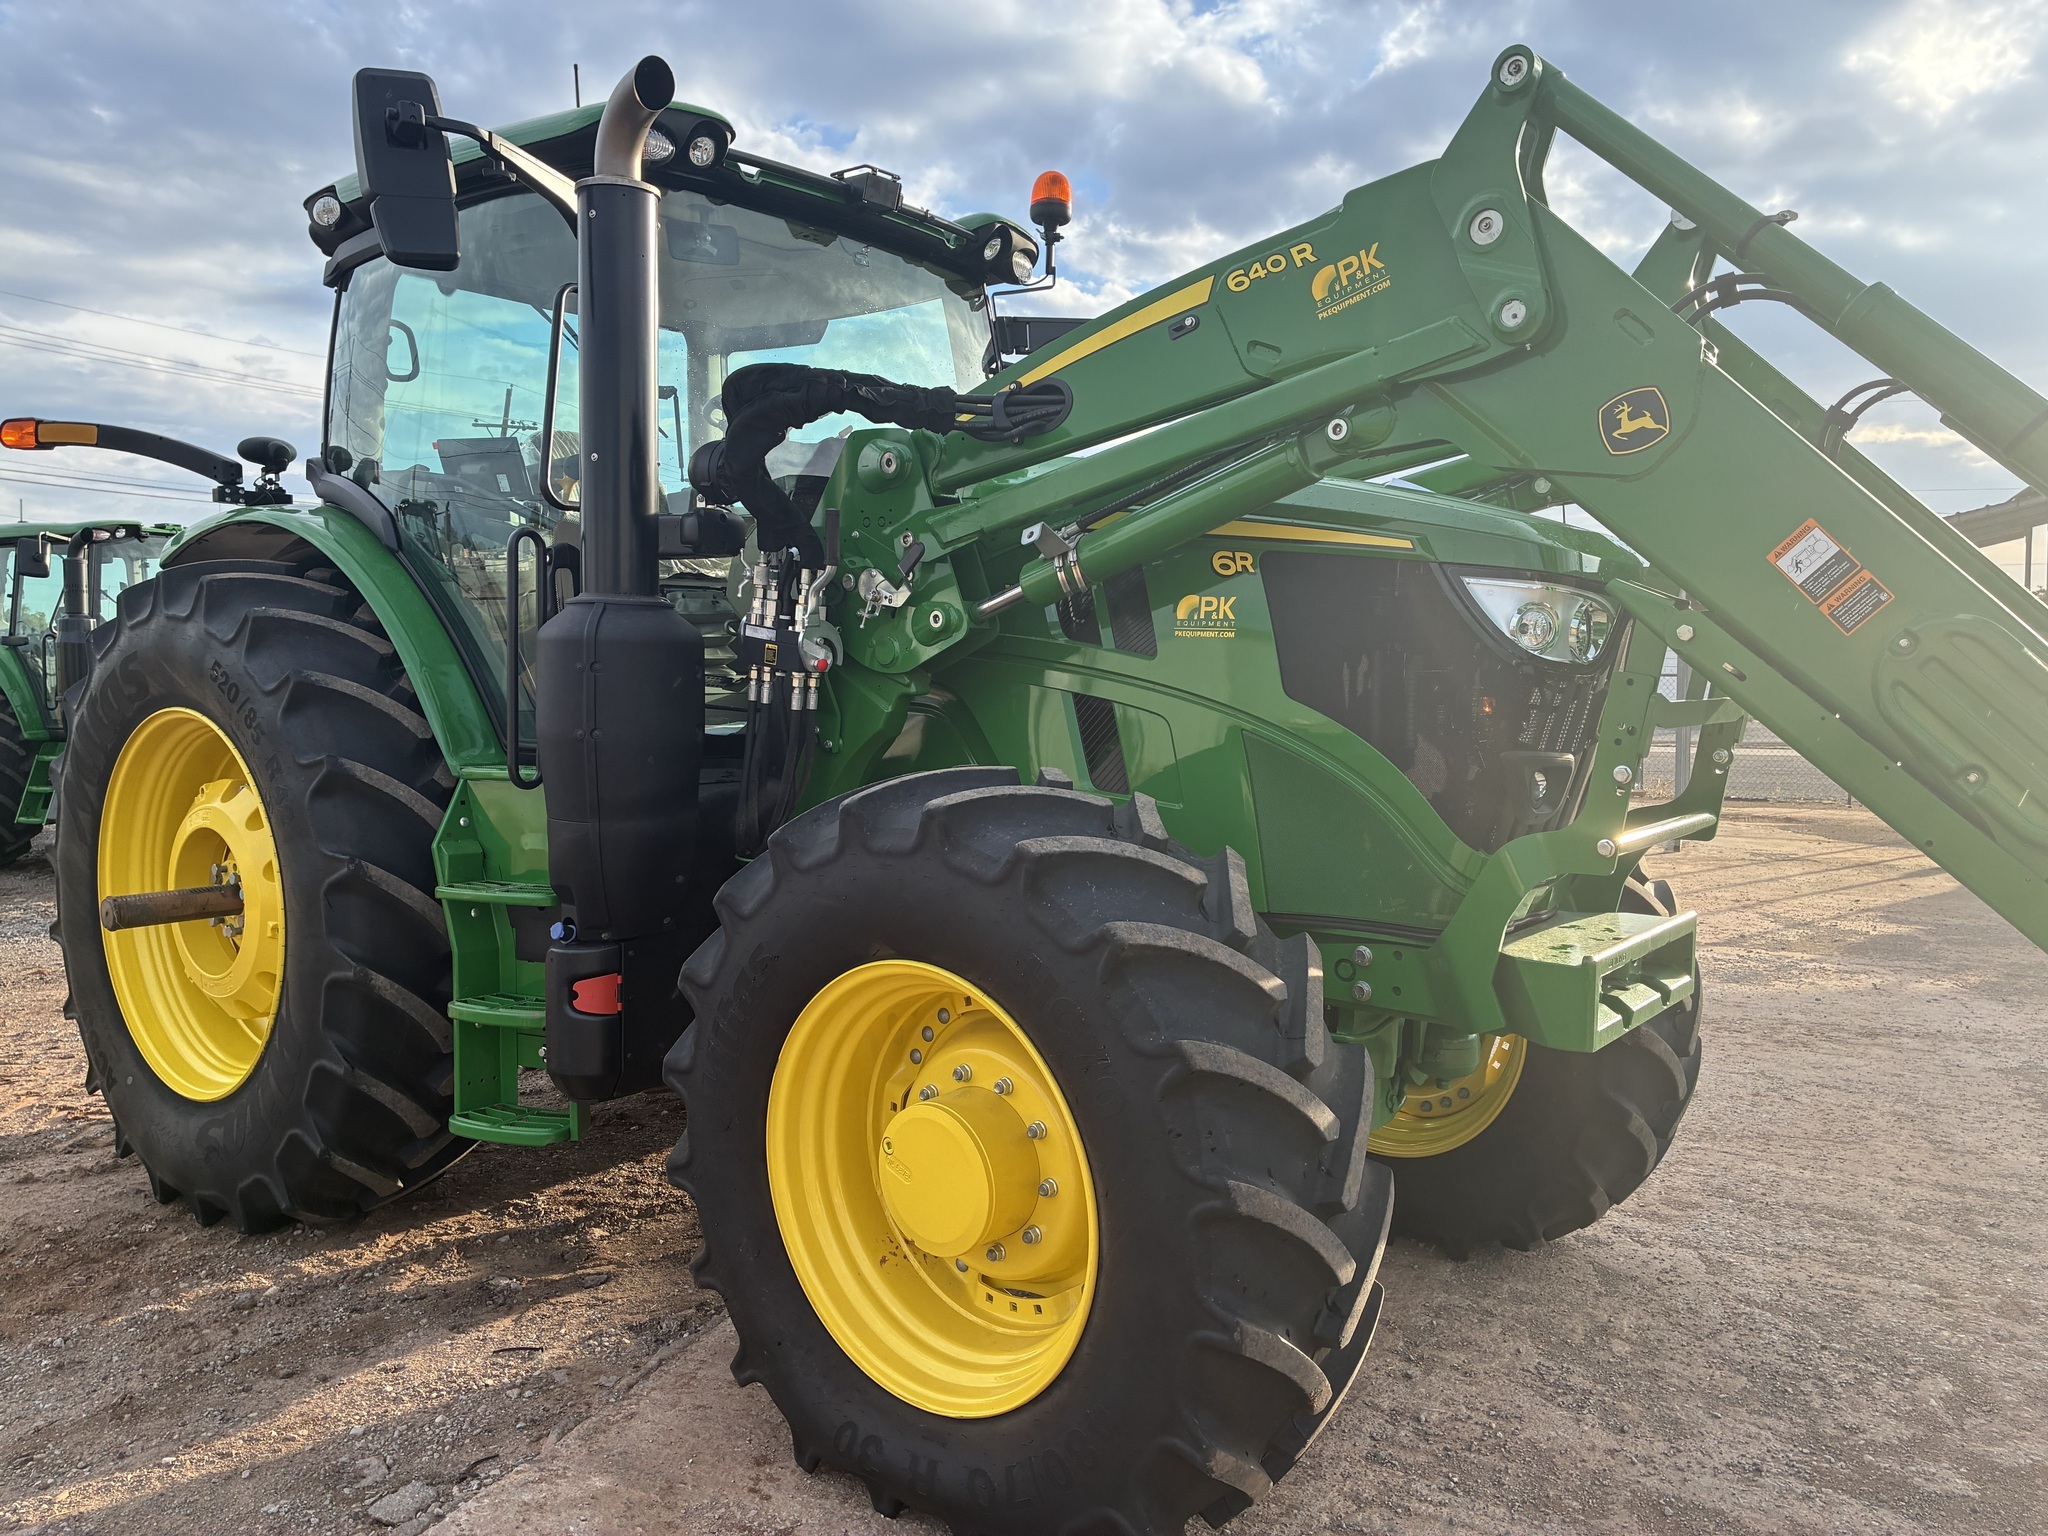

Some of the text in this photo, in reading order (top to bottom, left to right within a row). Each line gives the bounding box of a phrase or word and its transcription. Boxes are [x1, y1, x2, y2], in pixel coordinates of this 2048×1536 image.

[1317, 269, 1387, 308] EQUIPMENT
[1318, 279, 1391, 320] PKEQUIPMENT.COM
[1780, 524, 1811, 554] WARNING
[1211, 550, 1256, 577] 6R
[1834, 575, 1866, 603] WARNING
[1174, 630, 1235, 638] PKEQUIPMENT.COM
[1177, 620, 1235, 628] EQUIPMENT
[209, 659, 266, 746] 520/85
